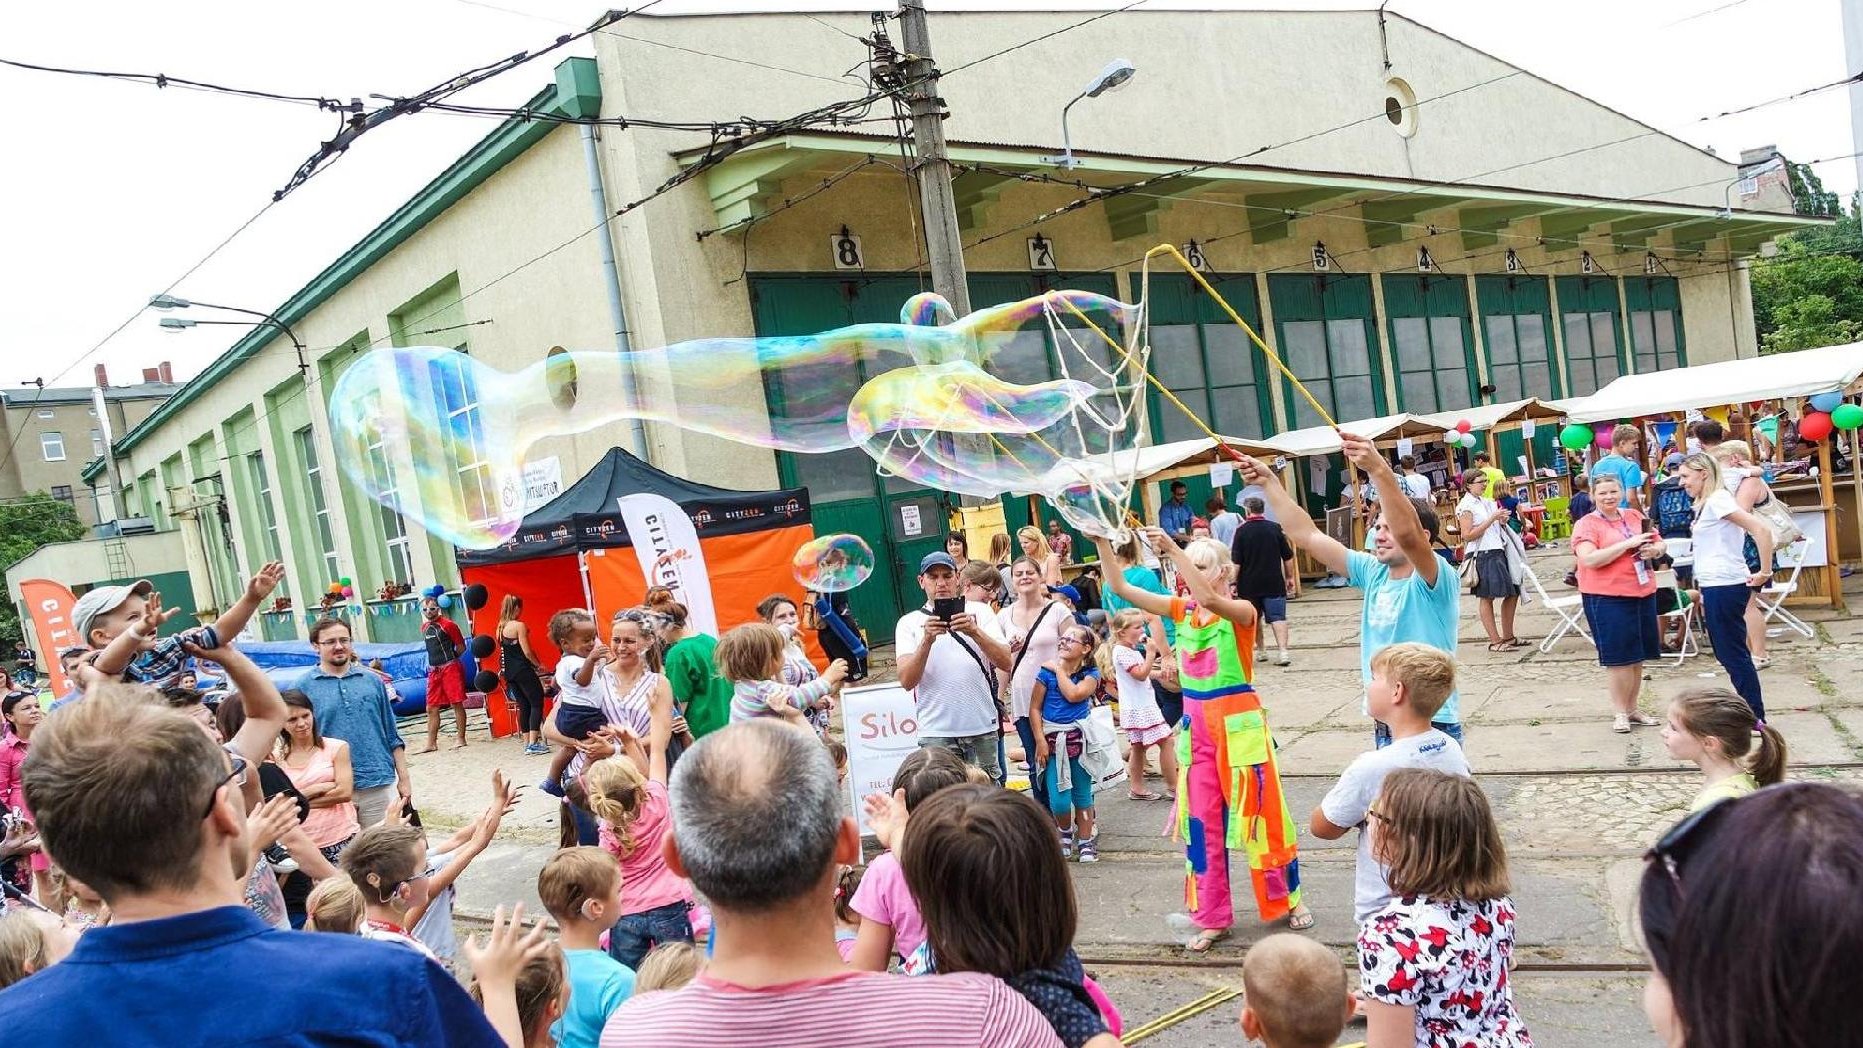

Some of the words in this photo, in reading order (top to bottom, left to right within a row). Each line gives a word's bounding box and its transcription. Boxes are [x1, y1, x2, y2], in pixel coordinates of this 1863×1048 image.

[838, 238, 857, 266] 8
[1032, 240, 1048, 266] 7
[1188, 248, 1201, 268] 6
[1315, 247, 1327, 268] 5
[1419, 249, 1430, 269] 4
[1507, 252, 1516, 270] 3
[1582, 255, 1591, 271] 2
[585, 525, 615, 534] CITYZEN
